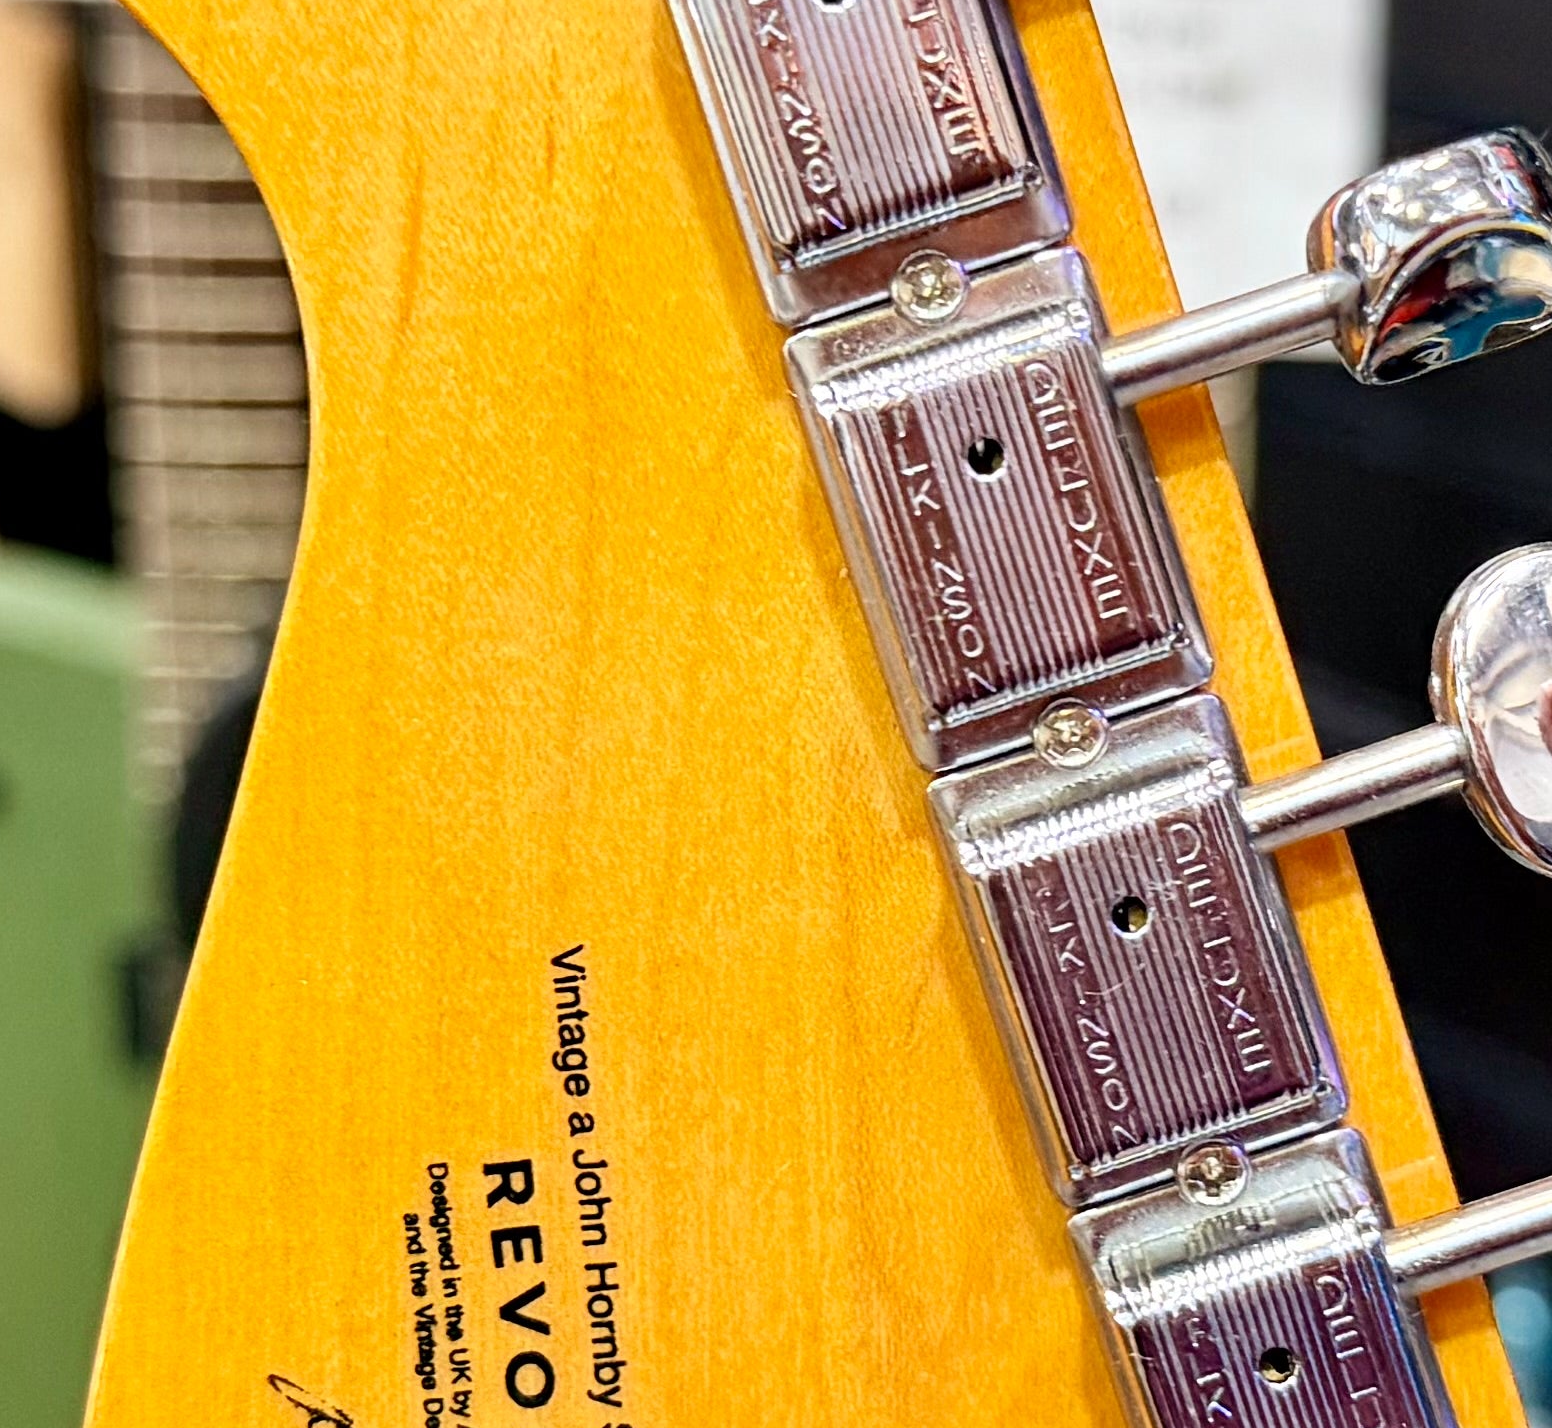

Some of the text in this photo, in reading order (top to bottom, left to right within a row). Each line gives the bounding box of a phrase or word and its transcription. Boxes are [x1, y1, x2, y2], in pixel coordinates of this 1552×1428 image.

[874, 376, 998, 697] ILKINSON
[1019, 833, 1139, 1149] ILKINSON
[1166, 819, 1270, 1072] DELUXE
[550, 944, 591, 1098] Vintage
[567, 1111, 595, 1138] a
[402, 1213, 428, 1255] and
[426, 1162, 461, 1272] Designed
[572, 1148, 613, 1247] John
[409, 1260, 430, 1298] the
[441, 1276, 462, 1299] in
[444, 1304, 465, 1342] the
[482, 1158, 556, 1409] REVO
[414, 1303, 437, 1391] Vintage
[448, 1347, 473, 1385] UK
[583, 1261, 627, 1408] Hornby
[448, 1389, 473, 1418] by
